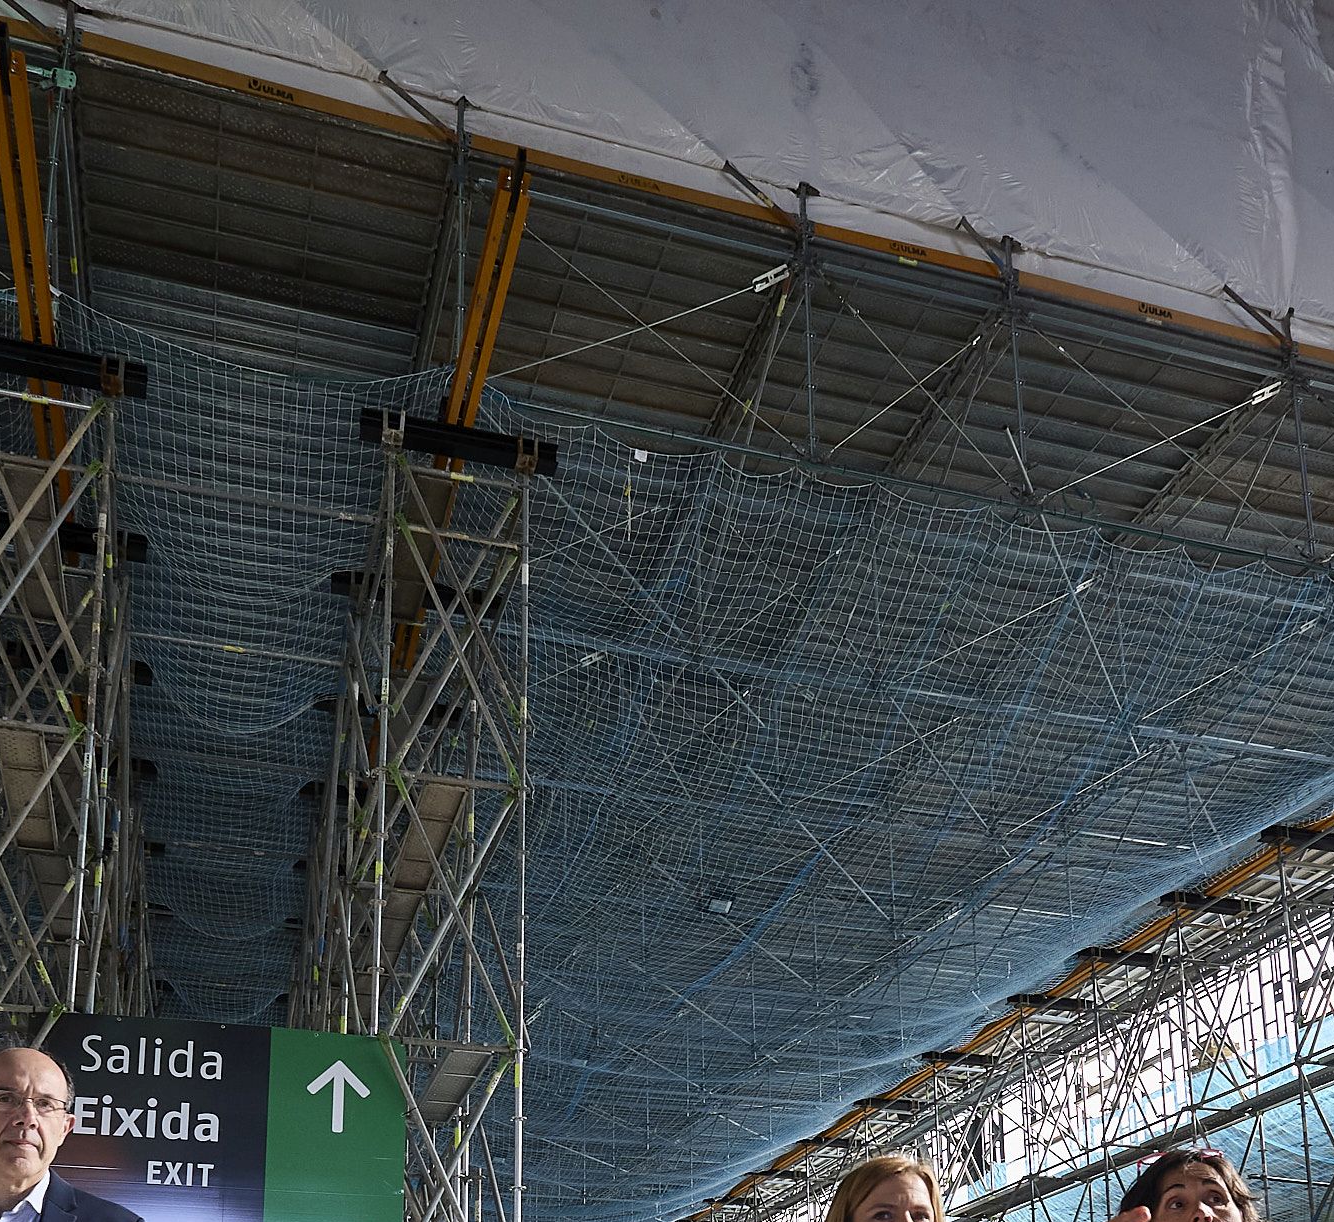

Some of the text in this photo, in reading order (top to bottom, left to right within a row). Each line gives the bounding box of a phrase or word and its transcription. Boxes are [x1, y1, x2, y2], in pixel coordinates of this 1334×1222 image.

[262, 85, 294, 101] ULMA
[80, 1034, 223, 1080] Salida
[72, 1094, 220, 1142] Eixida
[146, 1160, 215, 1188] EXIT
